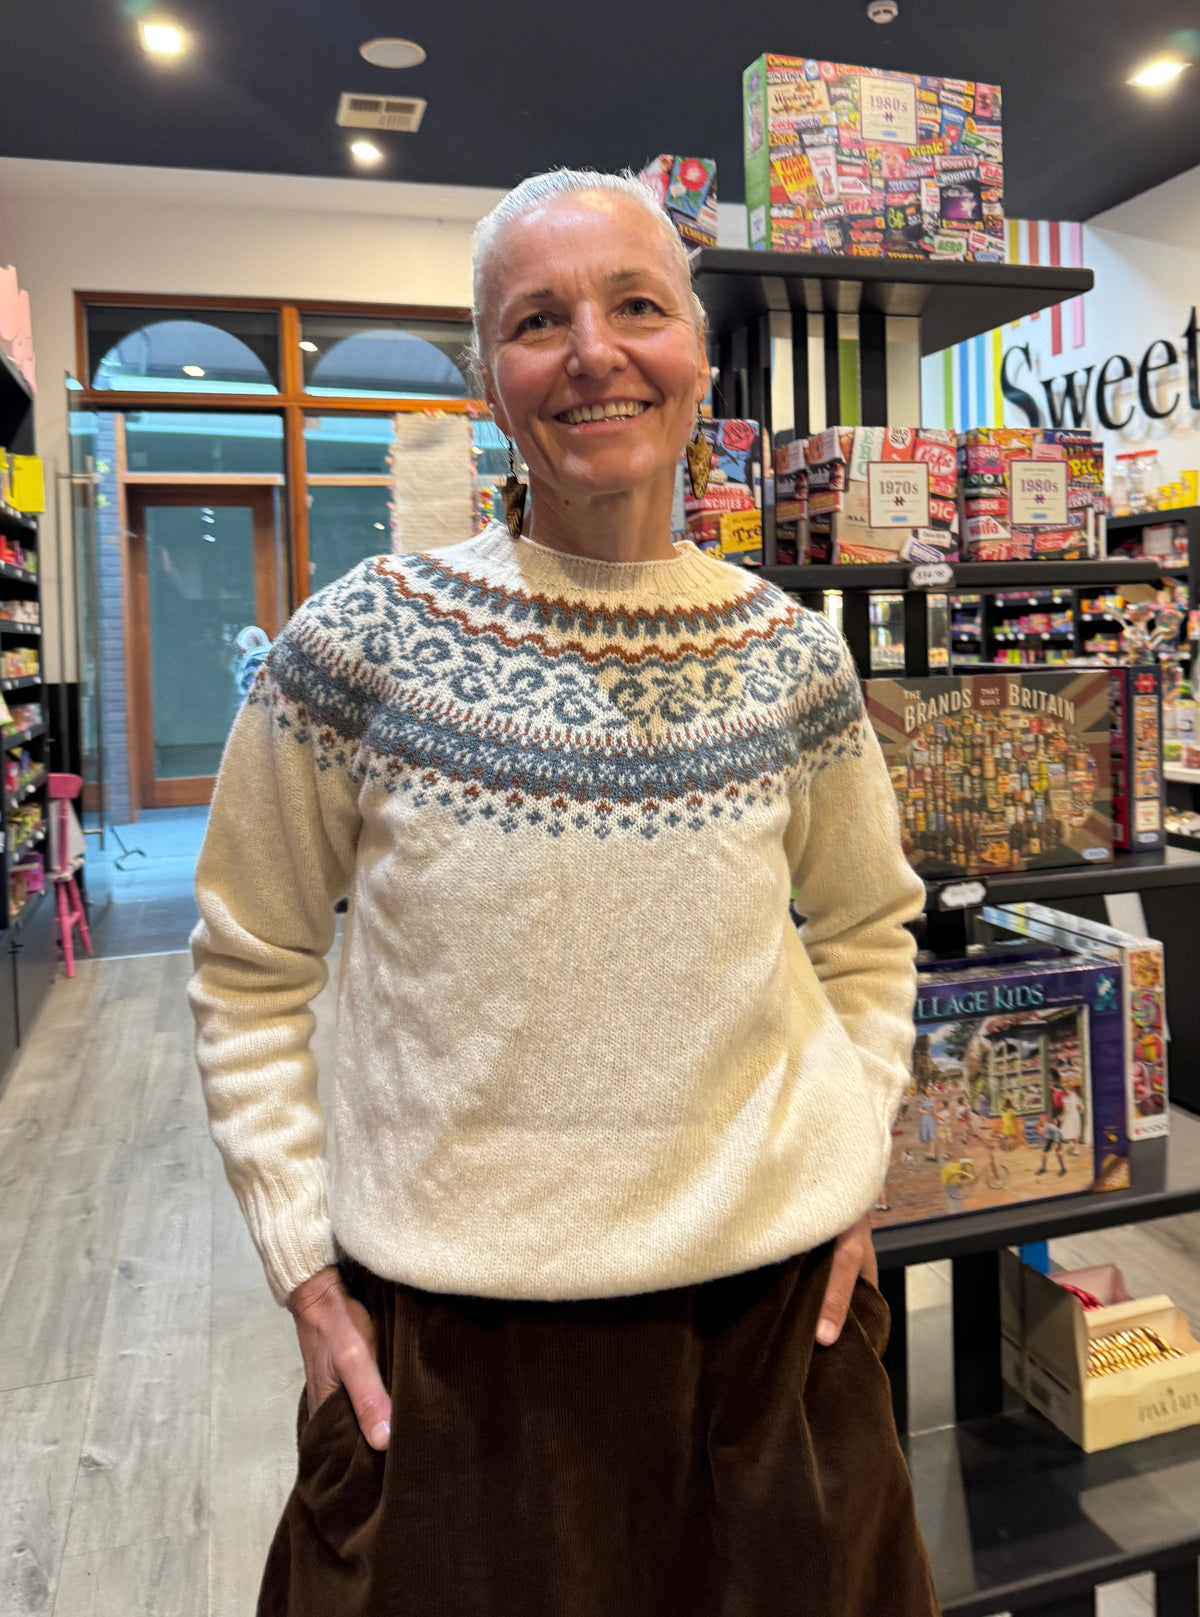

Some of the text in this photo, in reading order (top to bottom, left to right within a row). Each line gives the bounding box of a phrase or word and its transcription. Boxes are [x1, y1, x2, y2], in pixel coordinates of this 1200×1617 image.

[869, 95, 908, 113] 1980s
[1001, 306, 1200, 430] Sweet
[879, 481, 919, 495] 1970s
[1020, 479, 1058, 493] 1980s
[903, 690, 922, 700] THE
[1008, 683, 1076, 724] BRITAIN
[904, 688, 972, 733] BRANDS
[916, 991, 989, 1019] LLAGE
